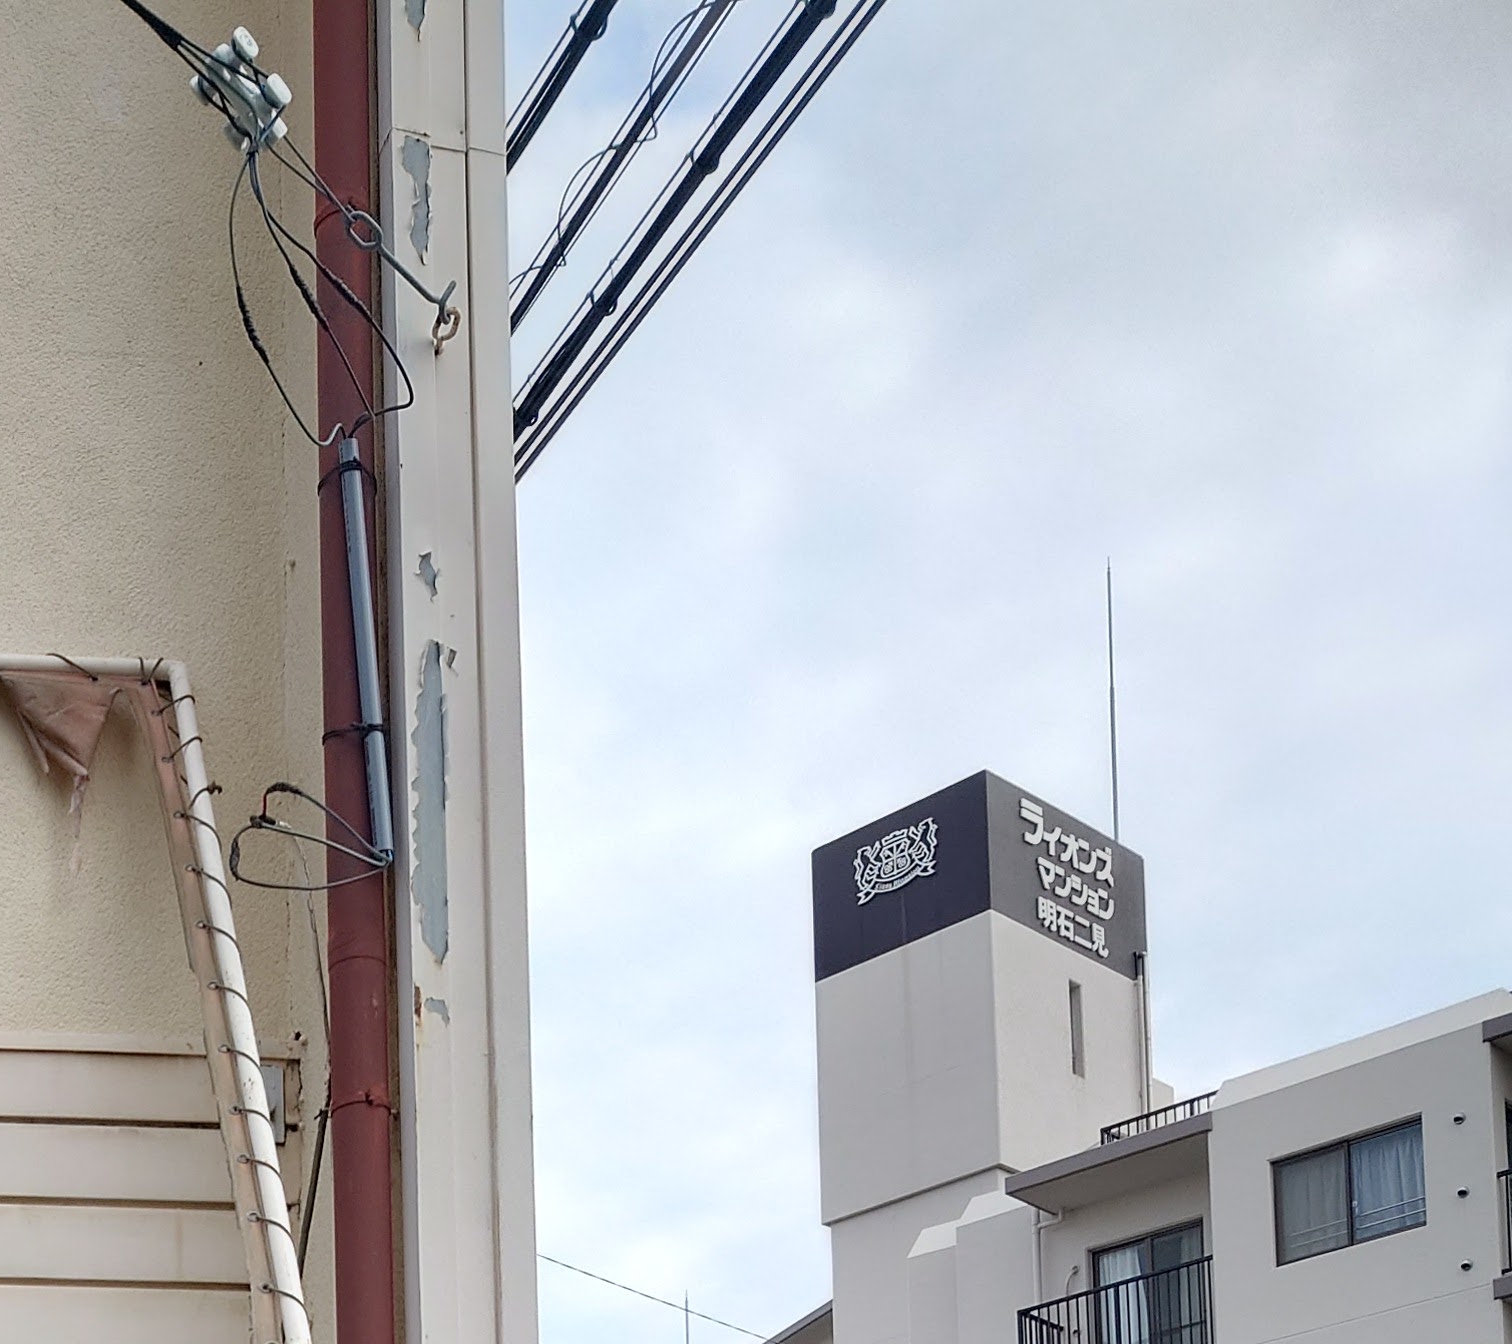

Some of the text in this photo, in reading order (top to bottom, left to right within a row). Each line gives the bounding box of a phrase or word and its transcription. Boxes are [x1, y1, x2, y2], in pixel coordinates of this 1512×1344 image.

[1019, 798, 1115, 887] ライオンズ
[1037, 856, 1115, 920] マンション
[1037, 896, 1109, 958] 明石二見
